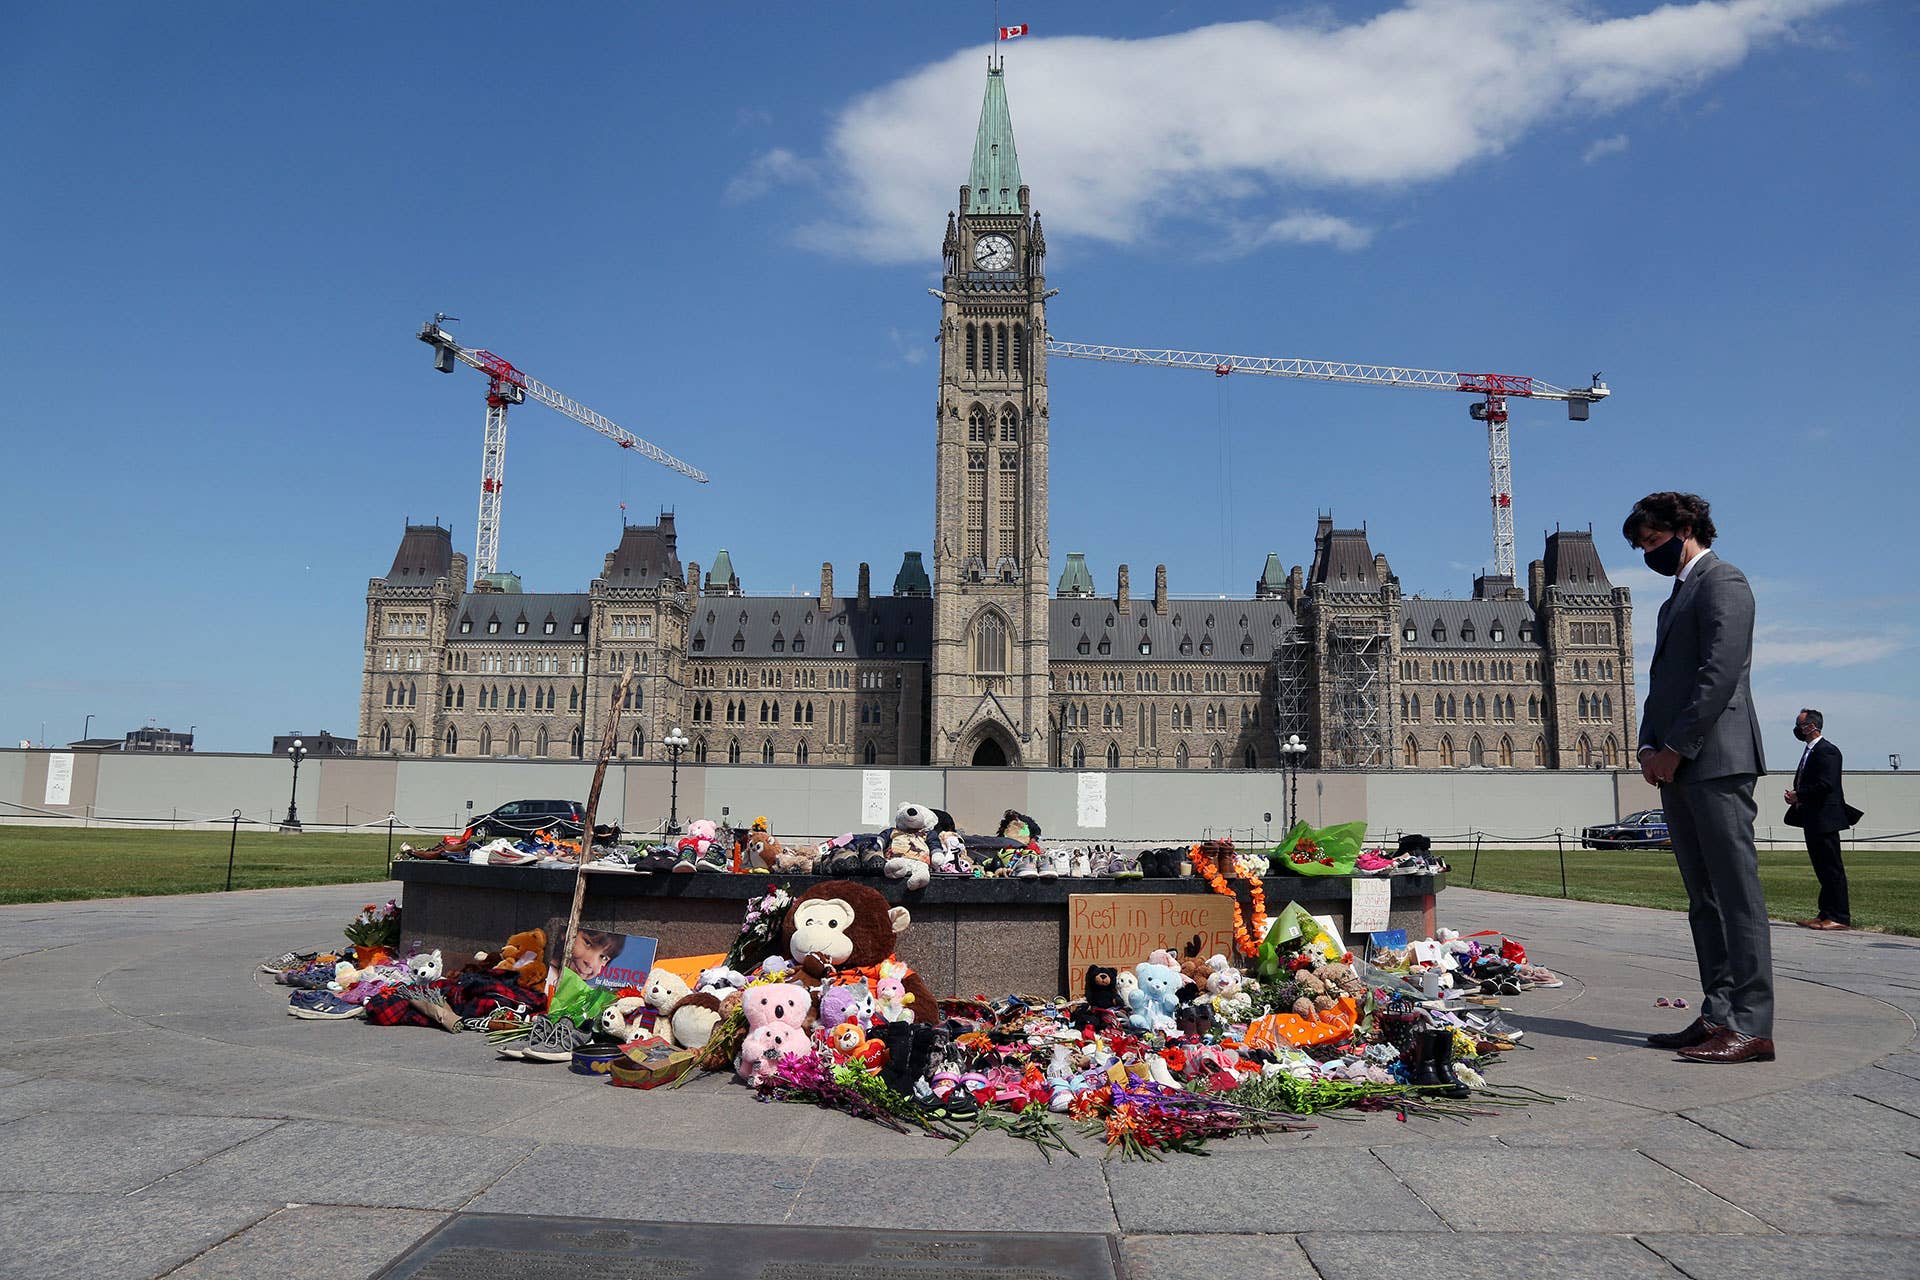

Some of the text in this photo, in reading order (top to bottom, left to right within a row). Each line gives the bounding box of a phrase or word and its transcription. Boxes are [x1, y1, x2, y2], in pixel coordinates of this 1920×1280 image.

[1074, 898, 1209, 930] Rest in Peace
[598, 966, 647, 985] JUSTICE
